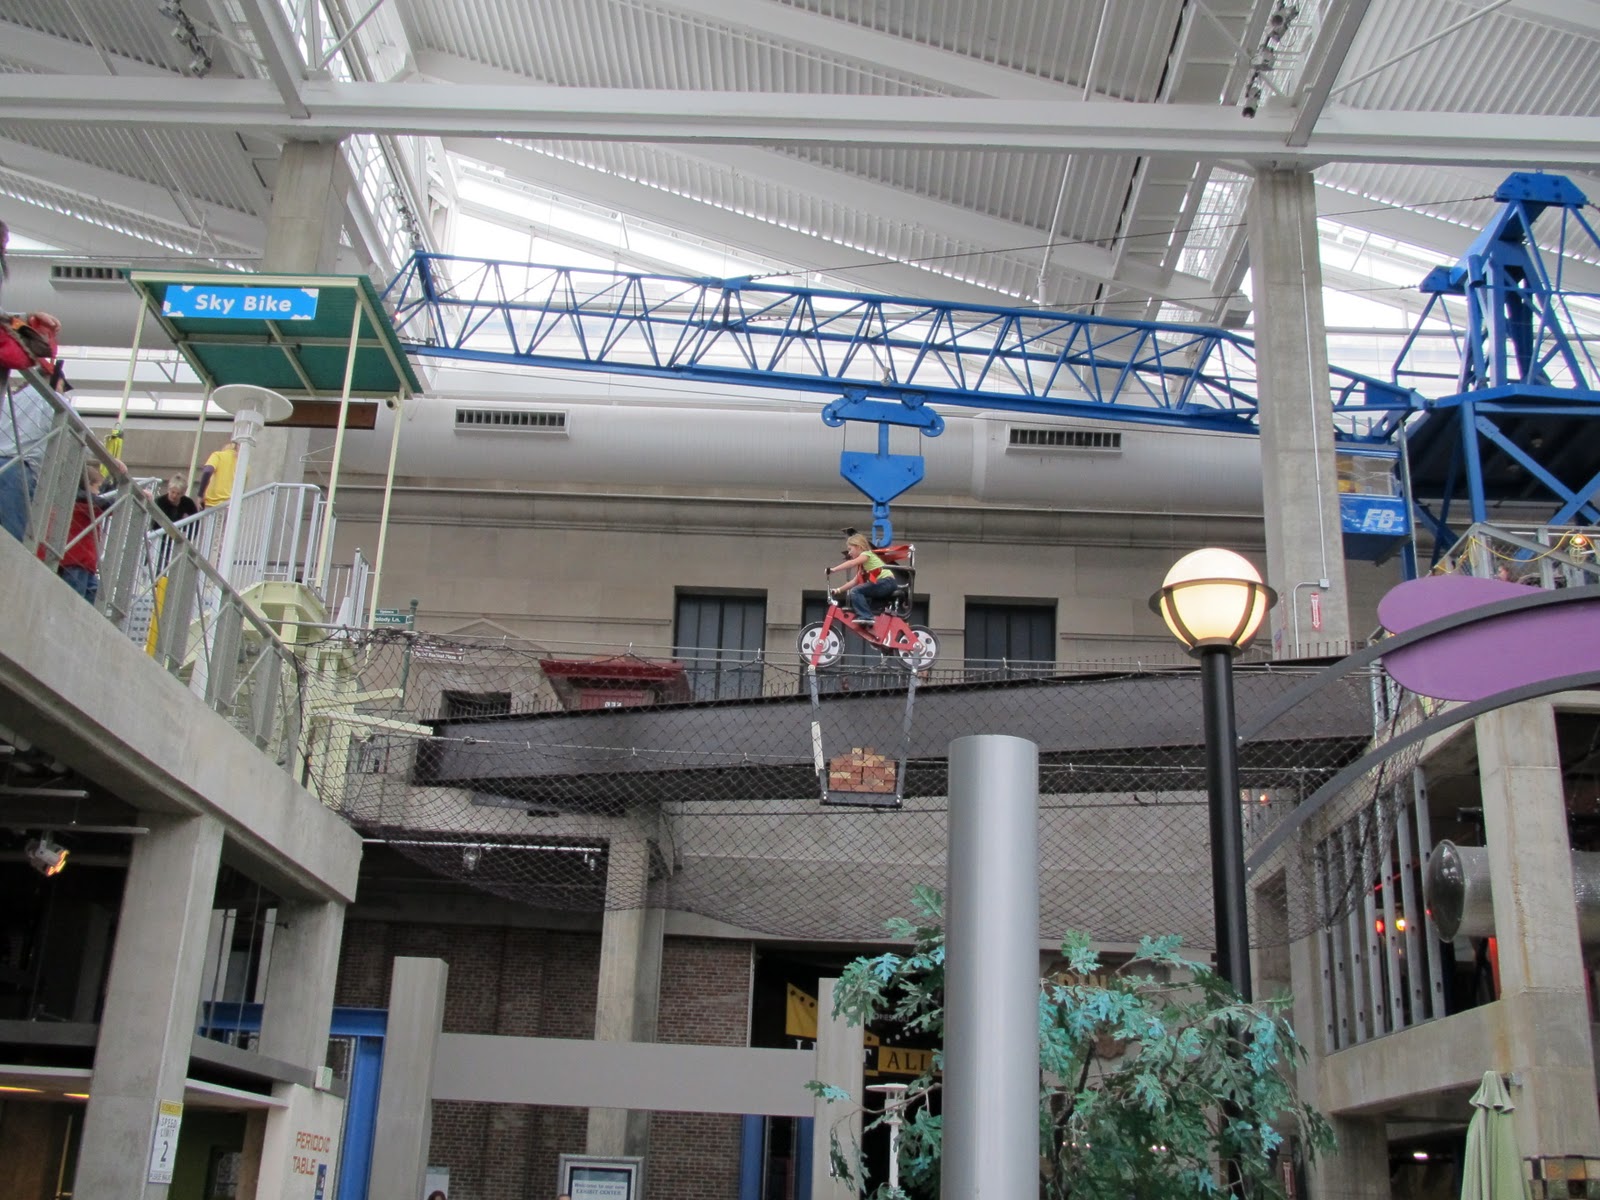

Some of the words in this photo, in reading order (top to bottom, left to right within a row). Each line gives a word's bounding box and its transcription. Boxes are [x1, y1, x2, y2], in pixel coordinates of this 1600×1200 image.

[195, 294, 235, 315] Sky
[243, 295, 292, 312] Bike
[1362, 508, 1396, 529] FB
[160, 1117, 178, 1129] SPEED
[160, 1140, 169, 1163] 2
[295, 1131, 331, 1153] PERIODIC
[292, 1155, 316, 1176] TABLE
